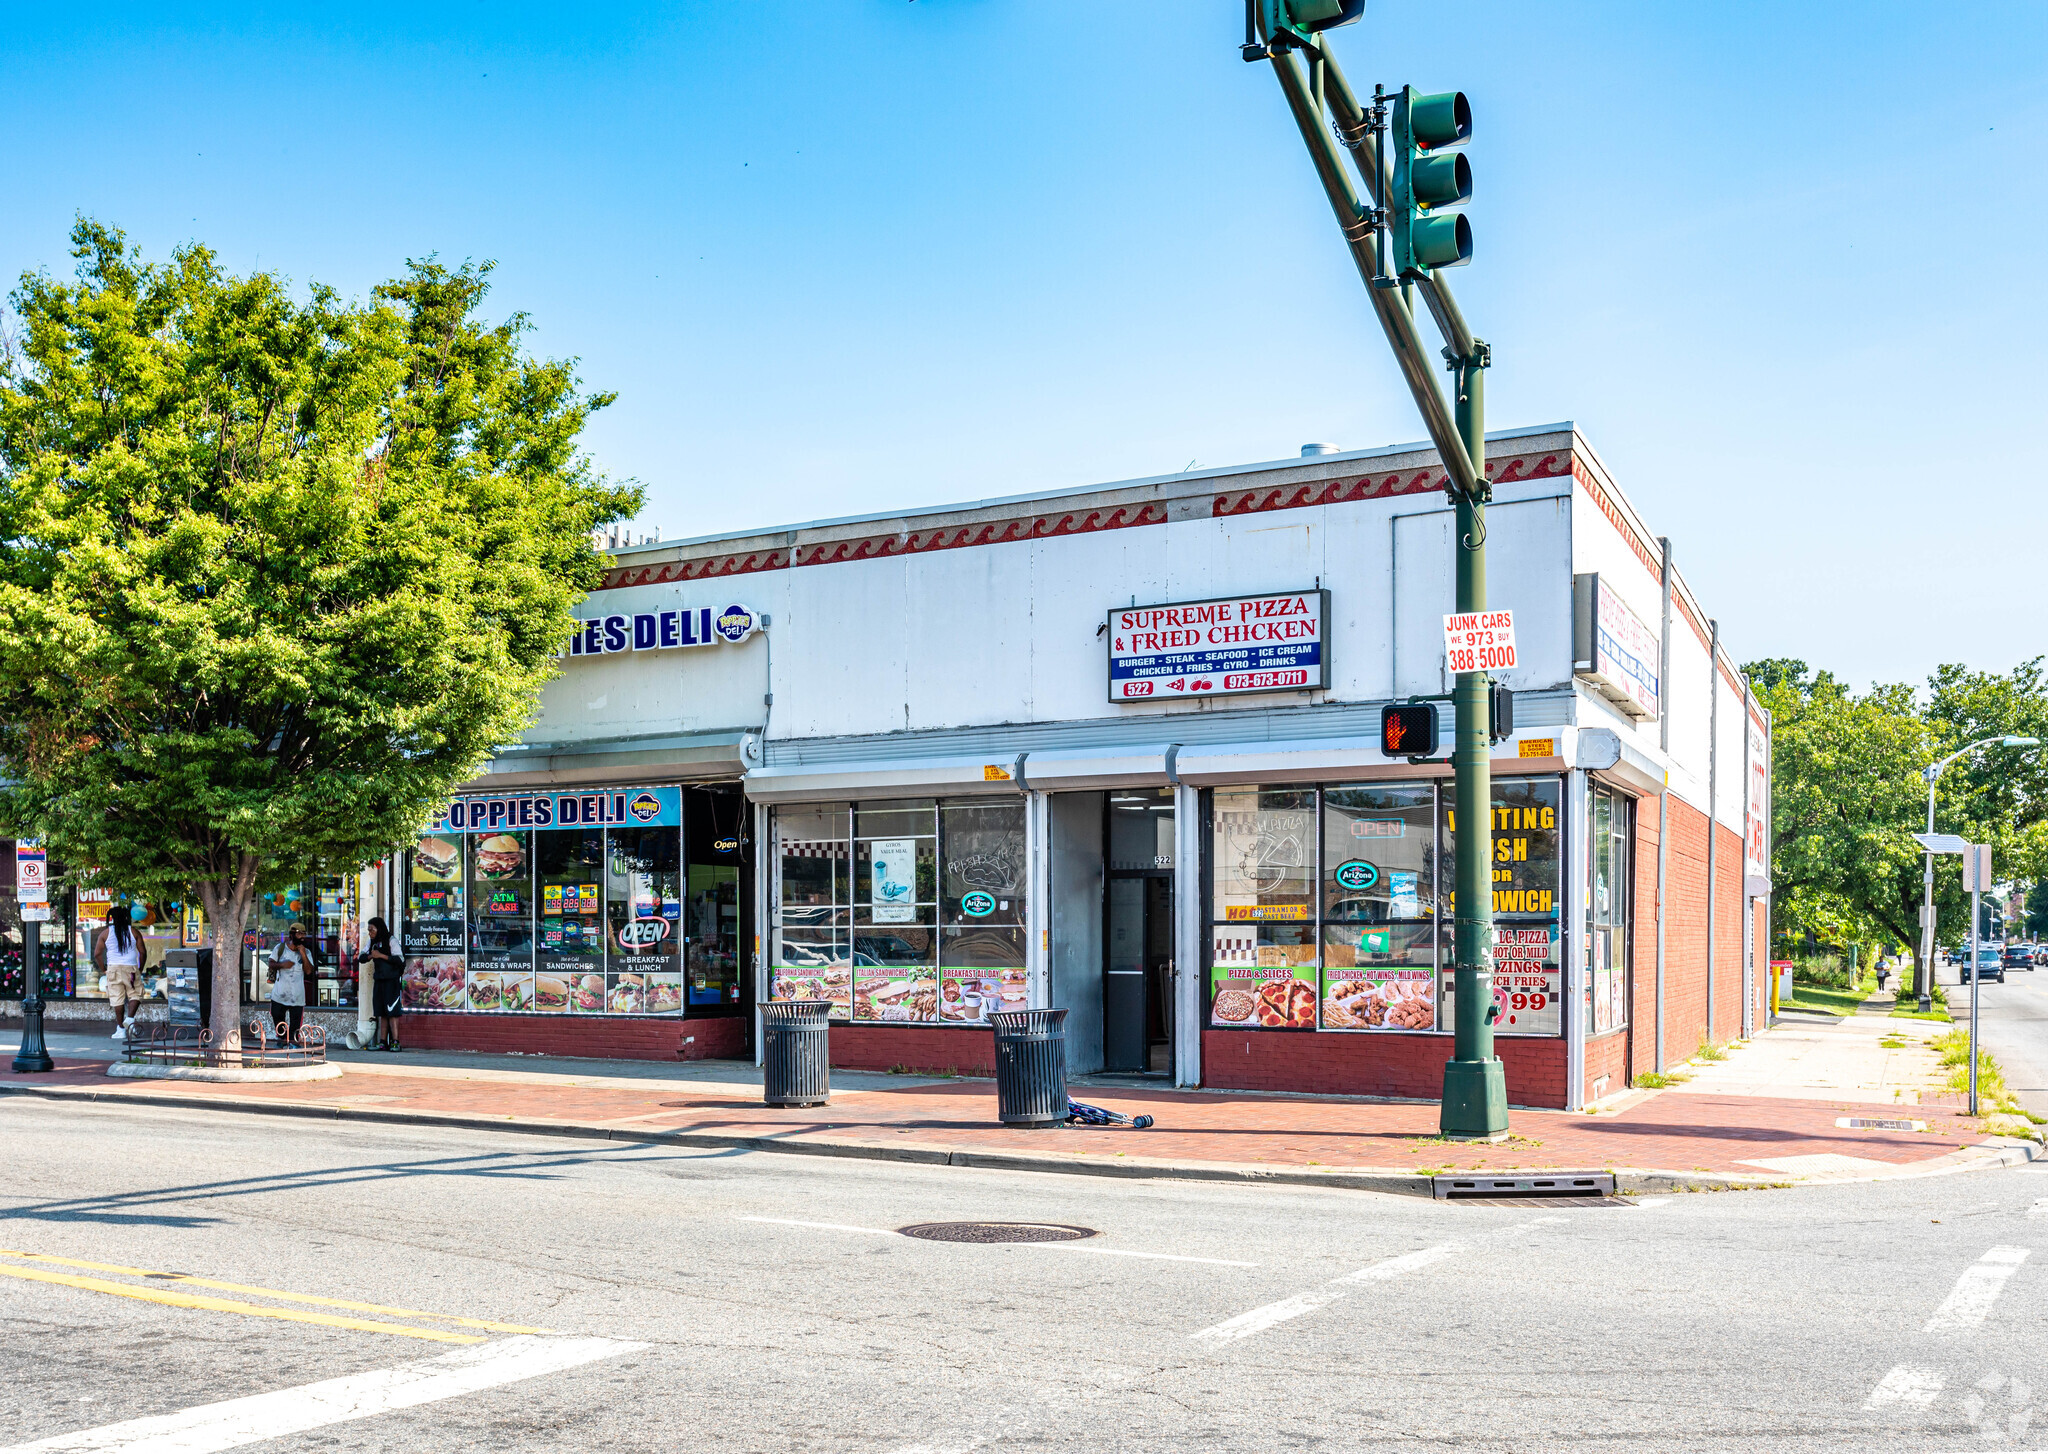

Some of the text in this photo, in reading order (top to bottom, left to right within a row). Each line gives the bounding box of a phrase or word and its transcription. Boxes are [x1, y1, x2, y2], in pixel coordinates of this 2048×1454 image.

[1121, 597, 1309, 631] SUPREME PIZZA
[1446, 613, 1511, 631] JUNK CARS
[632, 607, 712, 651] DELI
[1115, 619, 1317, 654] & FRIED CHICKEN
[1451, 631, 1509, 646] WE 973 BUY
[1119, 657, 1155, 667] BURGER
[1165, 654, 1195, 664] STEAK
[1205, 650, 1248, 660] SEAFOOD
[1259, 648, 1274, 656] ICE
[1277, 645, 1312, 655] CREAM
[1449, 645, 1515, 671] 388-5000
[1133, 666, 1173, 676] CHICKEN
[1176, 665, 1183, 673] &
[1186, 663, 1213, 672] FRIES
[1223, 660, 1249, 670] GYRO
[1259, 656, 1296, 667] DRINKS
[1127, 671, 1302, 695] 522 973-673-0711
[431, 793, 627, 831] POPPIES DELI
[1448, 807, 1555, 831] ITING
[1350, 822, 1400, 836] OPEN
[714, 840, 737, 850] Open
[1155, 856, 1170, 864] 522
[1342, 871, 1372, 880] AriZona
[1491, 869, 1512, 882] OR
[492, 893, 515, 902] ATM
[490, 903, 517, 911] CASH
[622, 922, 664, 941] OPEN
[1499, 931, 1548, 944] LG. PIZZA
[405, 934, 462, 946] Boar's Head
[1493, 947, 1548, 958] HOT OR MILD
[774, 967, 824, 977] CALIFORNIA SANDWICHES
[856, 968, 908, 977] ITALIAN SANDWICHES
[943, 969, 1000, 978] BREAKFAST ALL DAY
[1228, 968, 1293, 979] PIZZA & SLICES
[1327, 970, 1341, 980] FRIED
[1341, 970, 1363, 980] CHICKEN
[1366, 970, 1377, 980] HOT
[1377, 970, 1395, 980] WINGS
[1398, 970, 1411, 980] MILD
[1411, 970, 1430, 980] WINGS
[1514, 976, 1546, 986] FRIES
